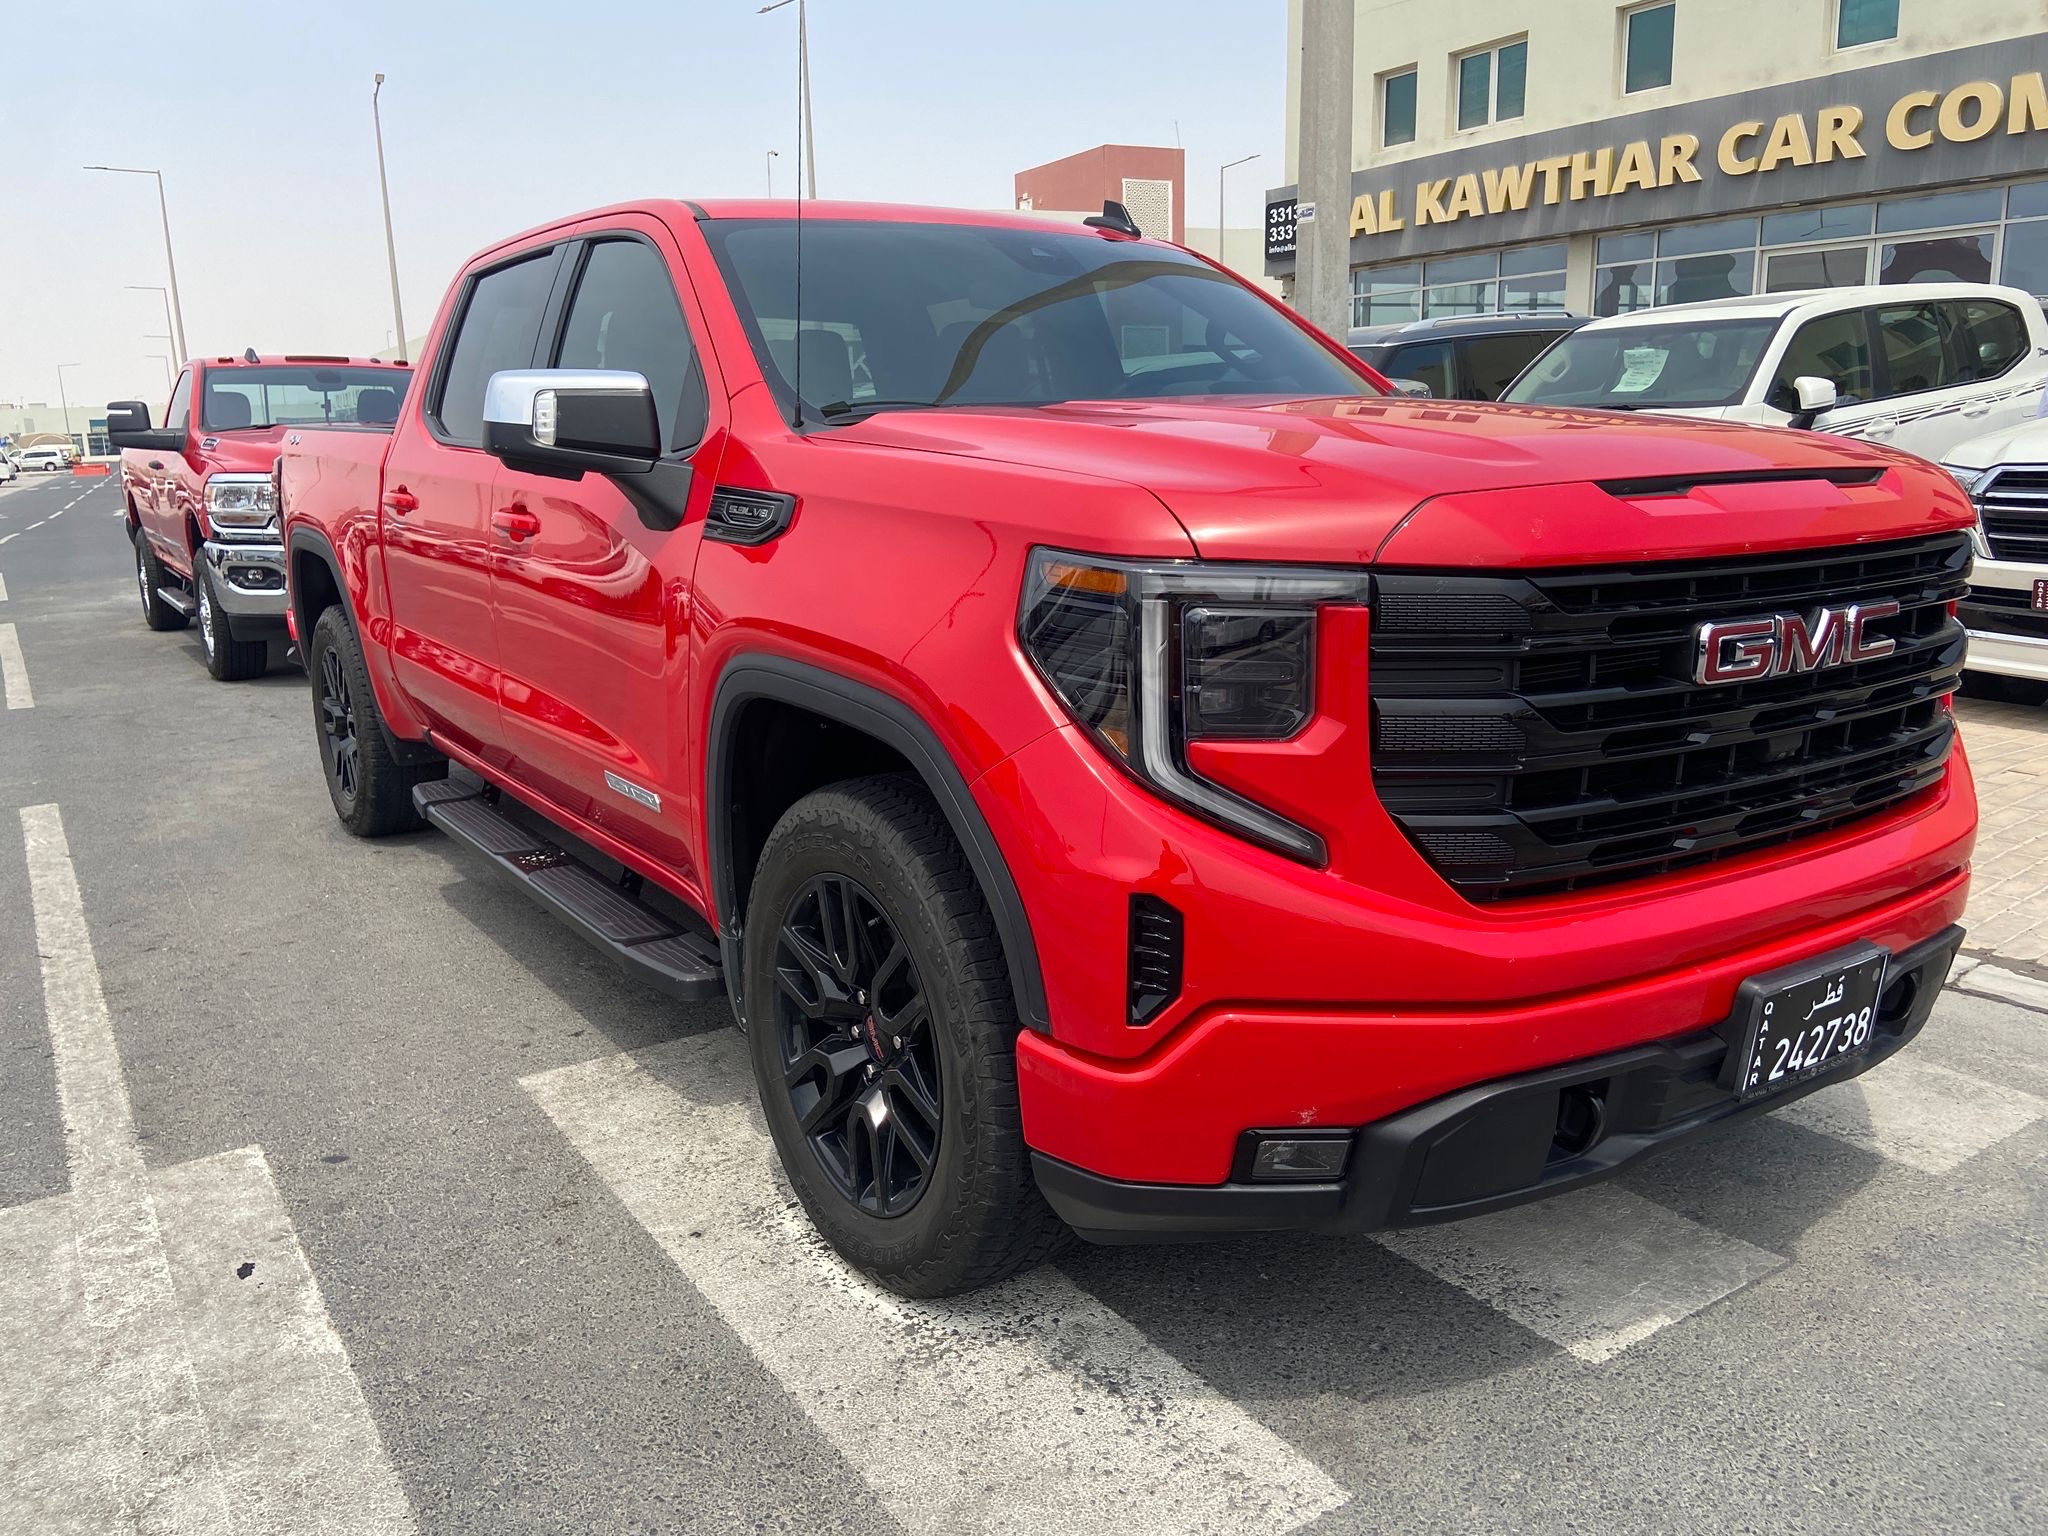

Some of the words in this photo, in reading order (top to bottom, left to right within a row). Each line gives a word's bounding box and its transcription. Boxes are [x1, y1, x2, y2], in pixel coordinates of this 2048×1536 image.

[1350, 190, 1405, 238] AL
[1415, 133, 1703, 226] KAWTHAR
[1717, 105, 1867, 176] CAR
[2036, 581, 2045, 608] QATAR
[1696, 600, 1900, 685] GMC
[1802, 975, 1846, 1021] قطر
[1749, 1001, 1774, 1086] QATAR
[1768, 1006, 1871, 1081] 242738
